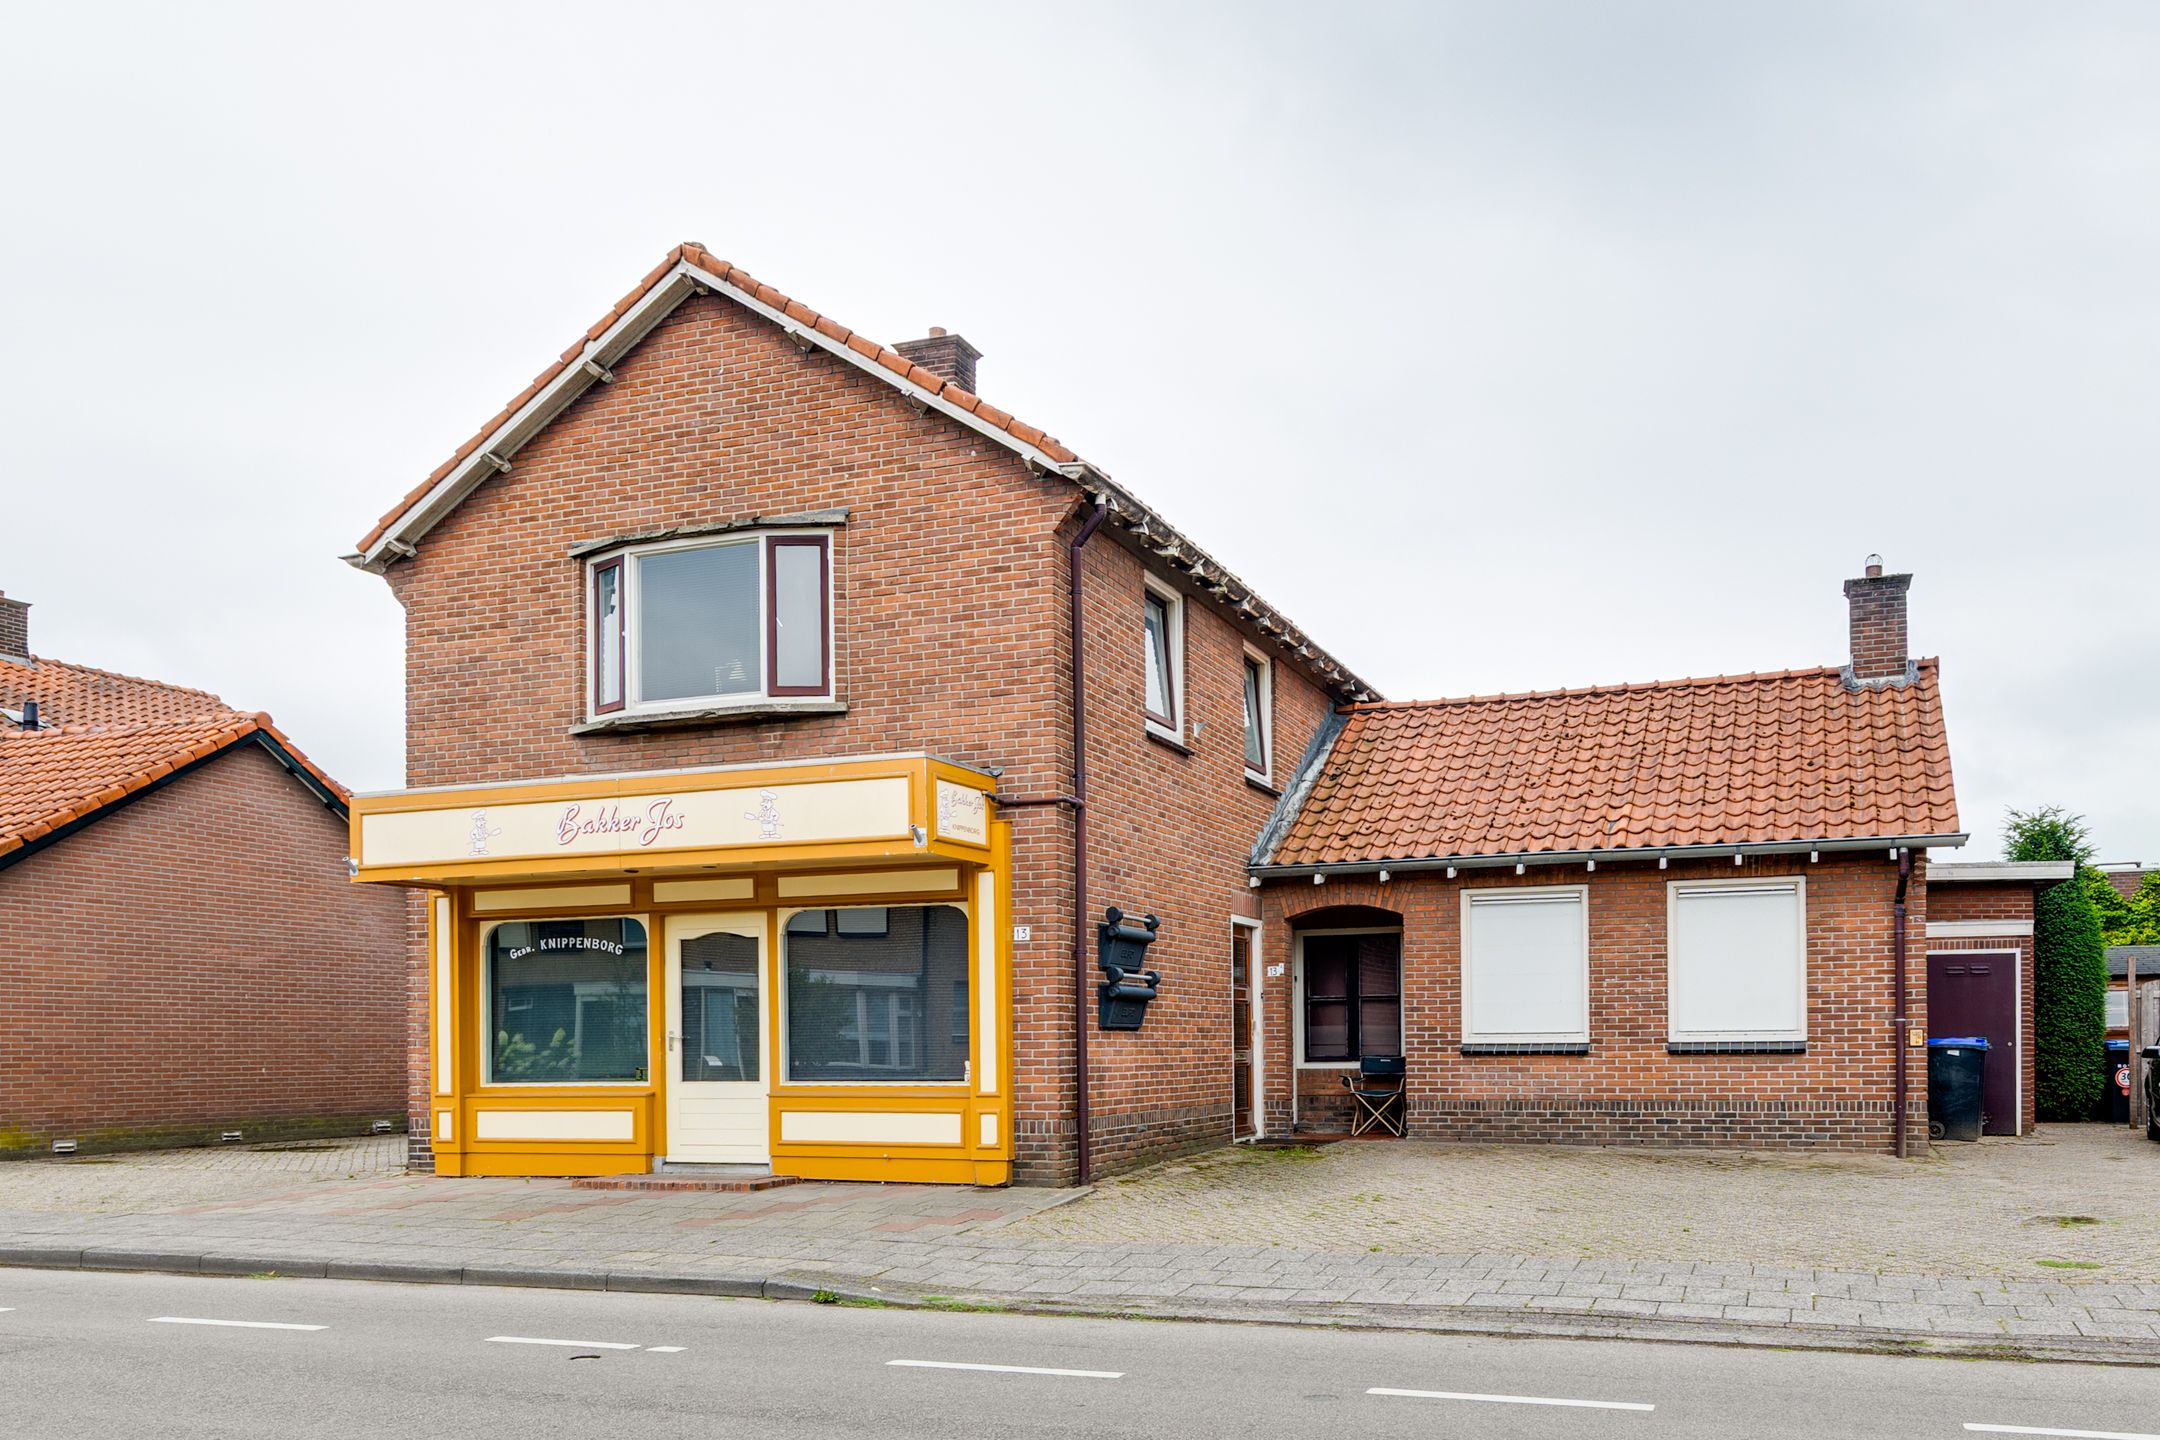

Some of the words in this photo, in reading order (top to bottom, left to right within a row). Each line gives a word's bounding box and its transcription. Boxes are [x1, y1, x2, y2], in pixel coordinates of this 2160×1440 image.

[557, 803, 641, 845] Bakker
[640, 797, 685, 846] Jos
[1016, 928, 1028, 939] 13
[540, 937, 624, 956] KNIPPENBORG
[1269, 967, 1278, 976] 13
